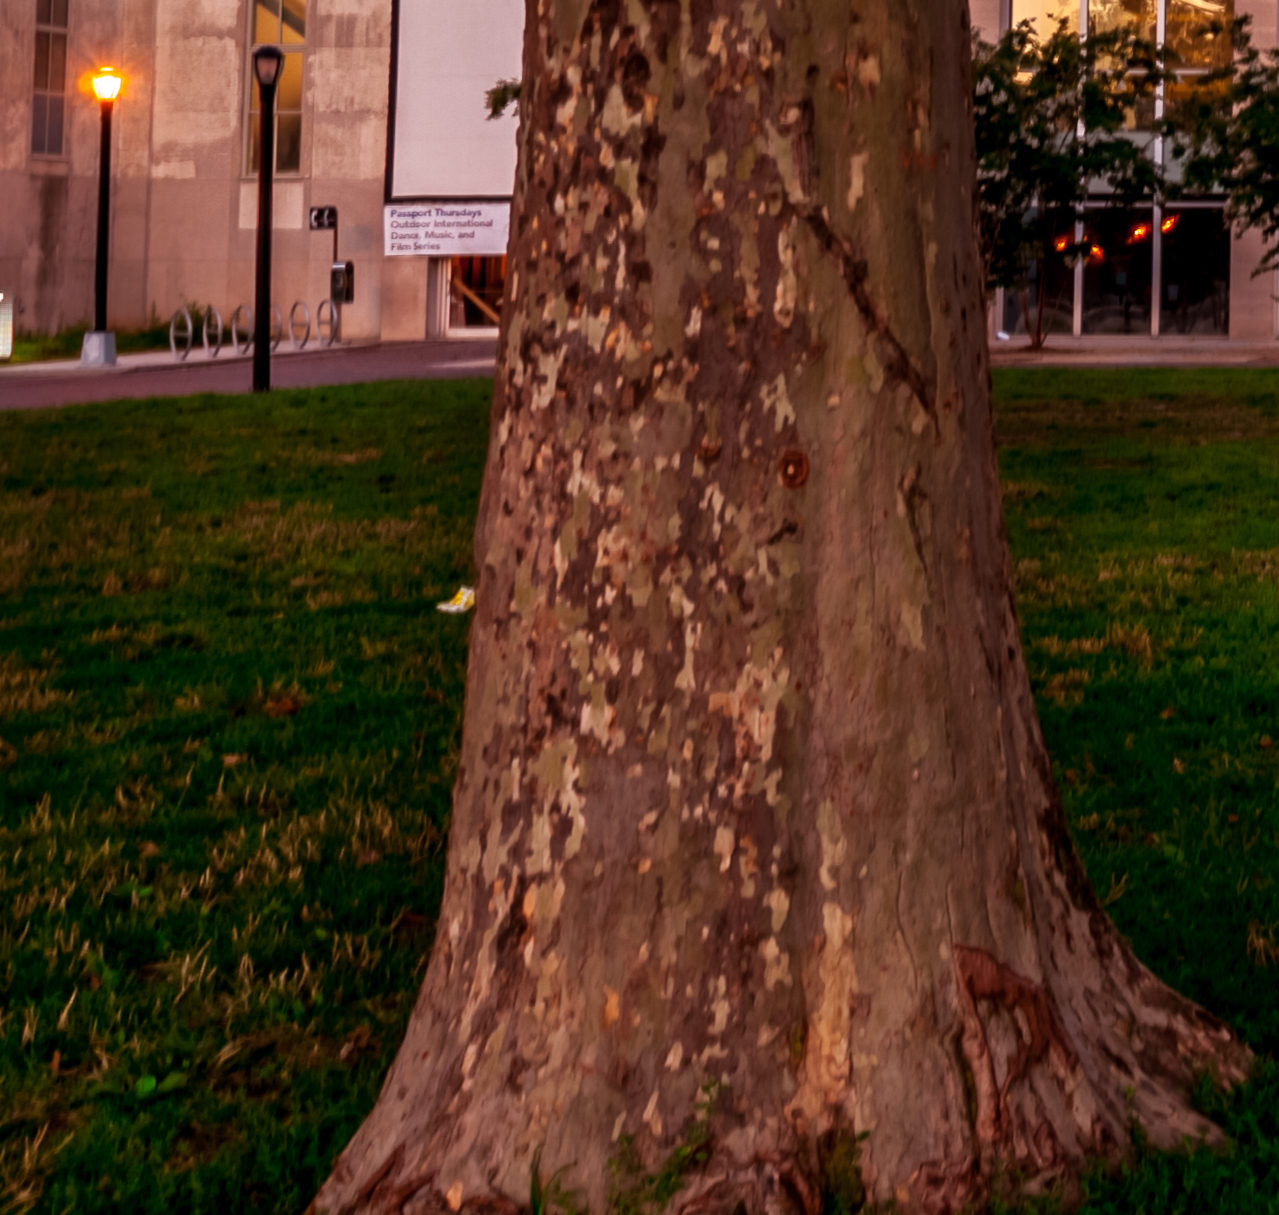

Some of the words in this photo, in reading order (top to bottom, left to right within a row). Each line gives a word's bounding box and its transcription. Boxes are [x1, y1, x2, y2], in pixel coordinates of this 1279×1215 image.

[391, 209, 432, 219] Passport
[435, 208, 482, 219] Thursdays
[391, 220, 430, 228] Outdoor
[434, 219, 493, 227] International
[458, 230, 475, 238] and
[391, 243, 411, 251] Film
[413, 241, 441, 251] Series
